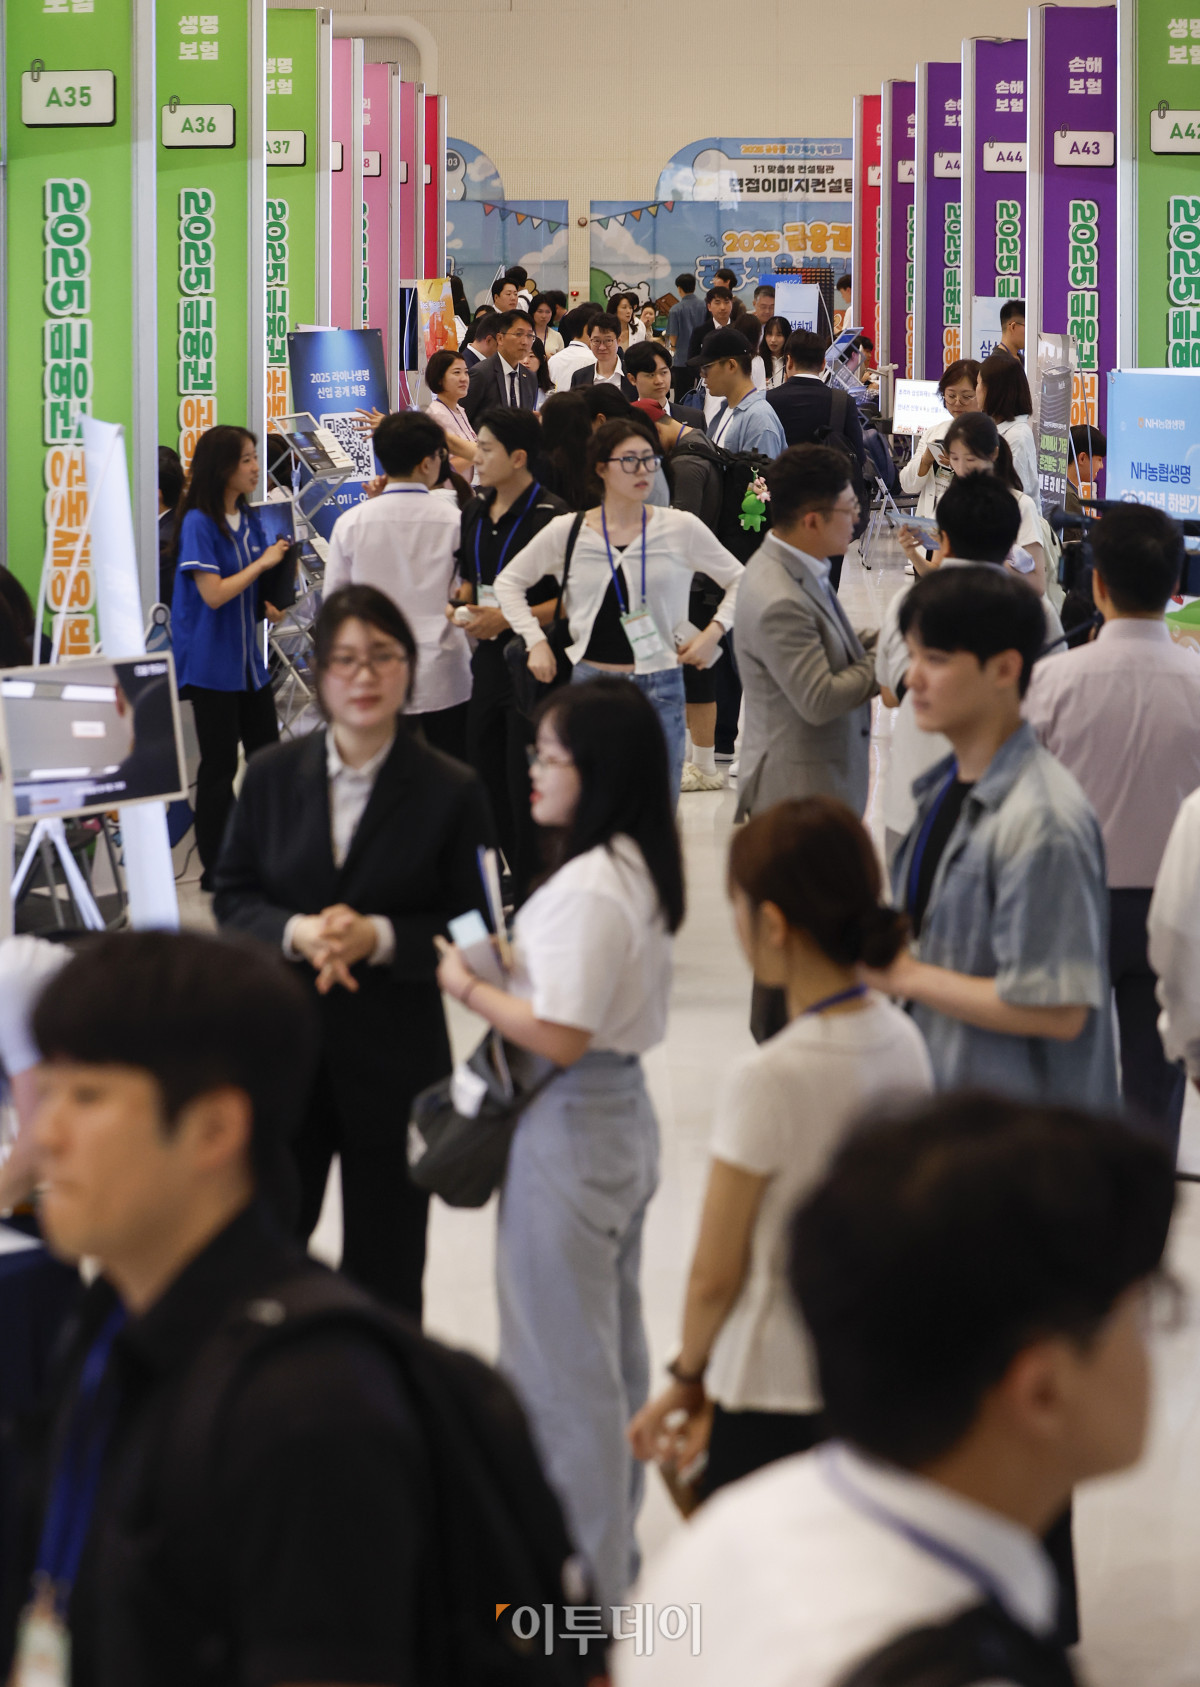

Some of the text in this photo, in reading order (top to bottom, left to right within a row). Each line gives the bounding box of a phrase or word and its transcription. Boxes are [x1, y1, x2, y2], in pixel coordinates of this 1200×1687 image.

[178, 15, 219, 35] 생명
[178, 41, 219, 61] 보험
[1068, 56, 1103, 74] 손해
[995, 80, 1024, 95] 손해
[1068, 78, 1103, 95] 보험
[45, 86, 92, 108] A35
[995, 98, 1024, 113] 보험
[180, 116, 217, 134] A36
[996, 151, 1023, 163] A44
[1069, 141, 1101, 155] A43
[753, 165, 765, 173] 1:1
[945, 160, 961, 170] A4
[49, 181, 88, 312] 2025
[181, 190, 213, 293] 2025
[266, 200, 287, 283] 2025
[724, 233, 780, 253] 2025
[996, 202, 1021, 273] 2025
[1070, 202, 1097, 287] 2025
[1173, 198, 1200, 302] 2025
[181, 298, 215, 393] 금융권
[310, 369, 370, 384] 2025 라이나생명
[317, 385, 367, 399] 신입 공개 채용
[1131, 461, 1191, 485] NH농협생명
